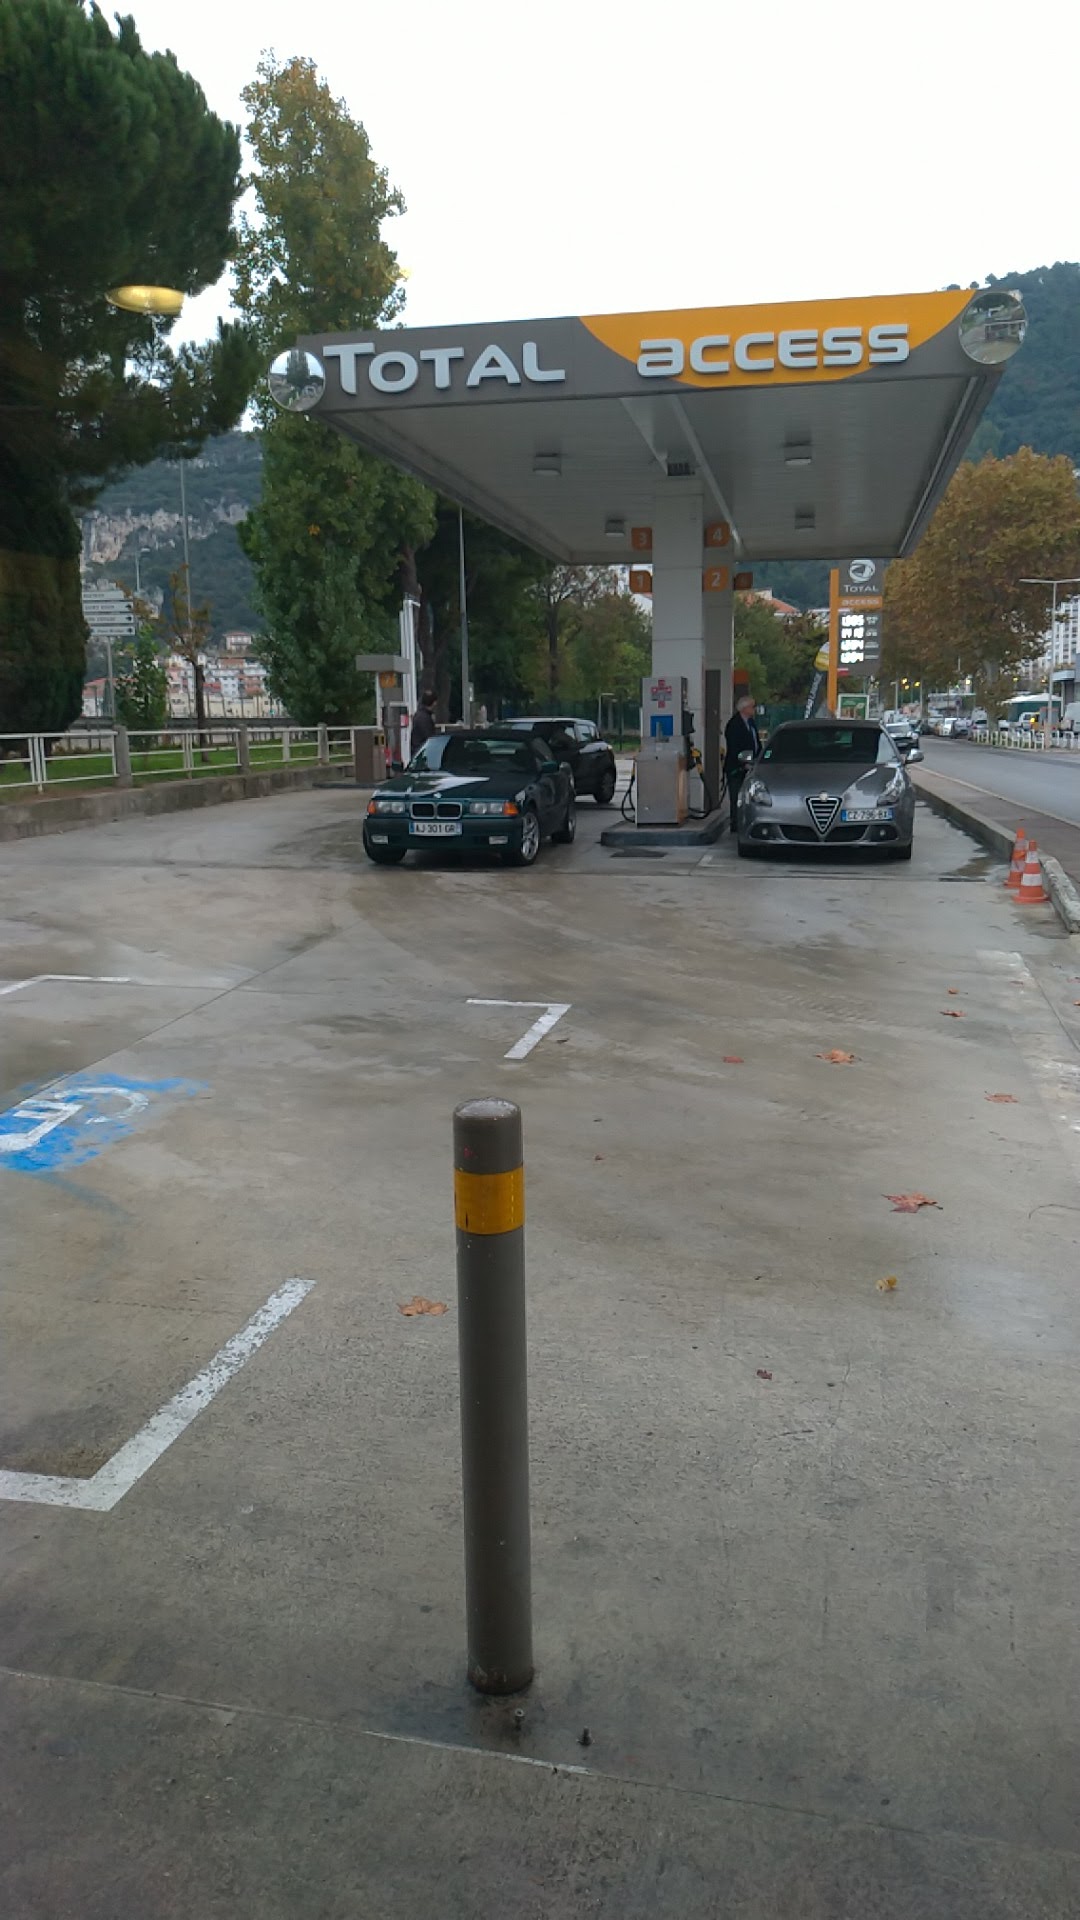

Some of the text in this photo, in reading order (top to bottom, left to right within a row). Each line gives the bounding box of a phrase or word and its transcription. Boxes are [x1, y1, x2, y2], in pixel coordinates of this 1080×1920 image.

[323, 341, 566, 395] TOTAL
[639, 532, 648, 545] 3
[712, 527, 723, 541] 4
[636, 574, 644, 588] 1
[711, 572, 721, 587] 2
[843, 584, 879, 593] TOTAL
